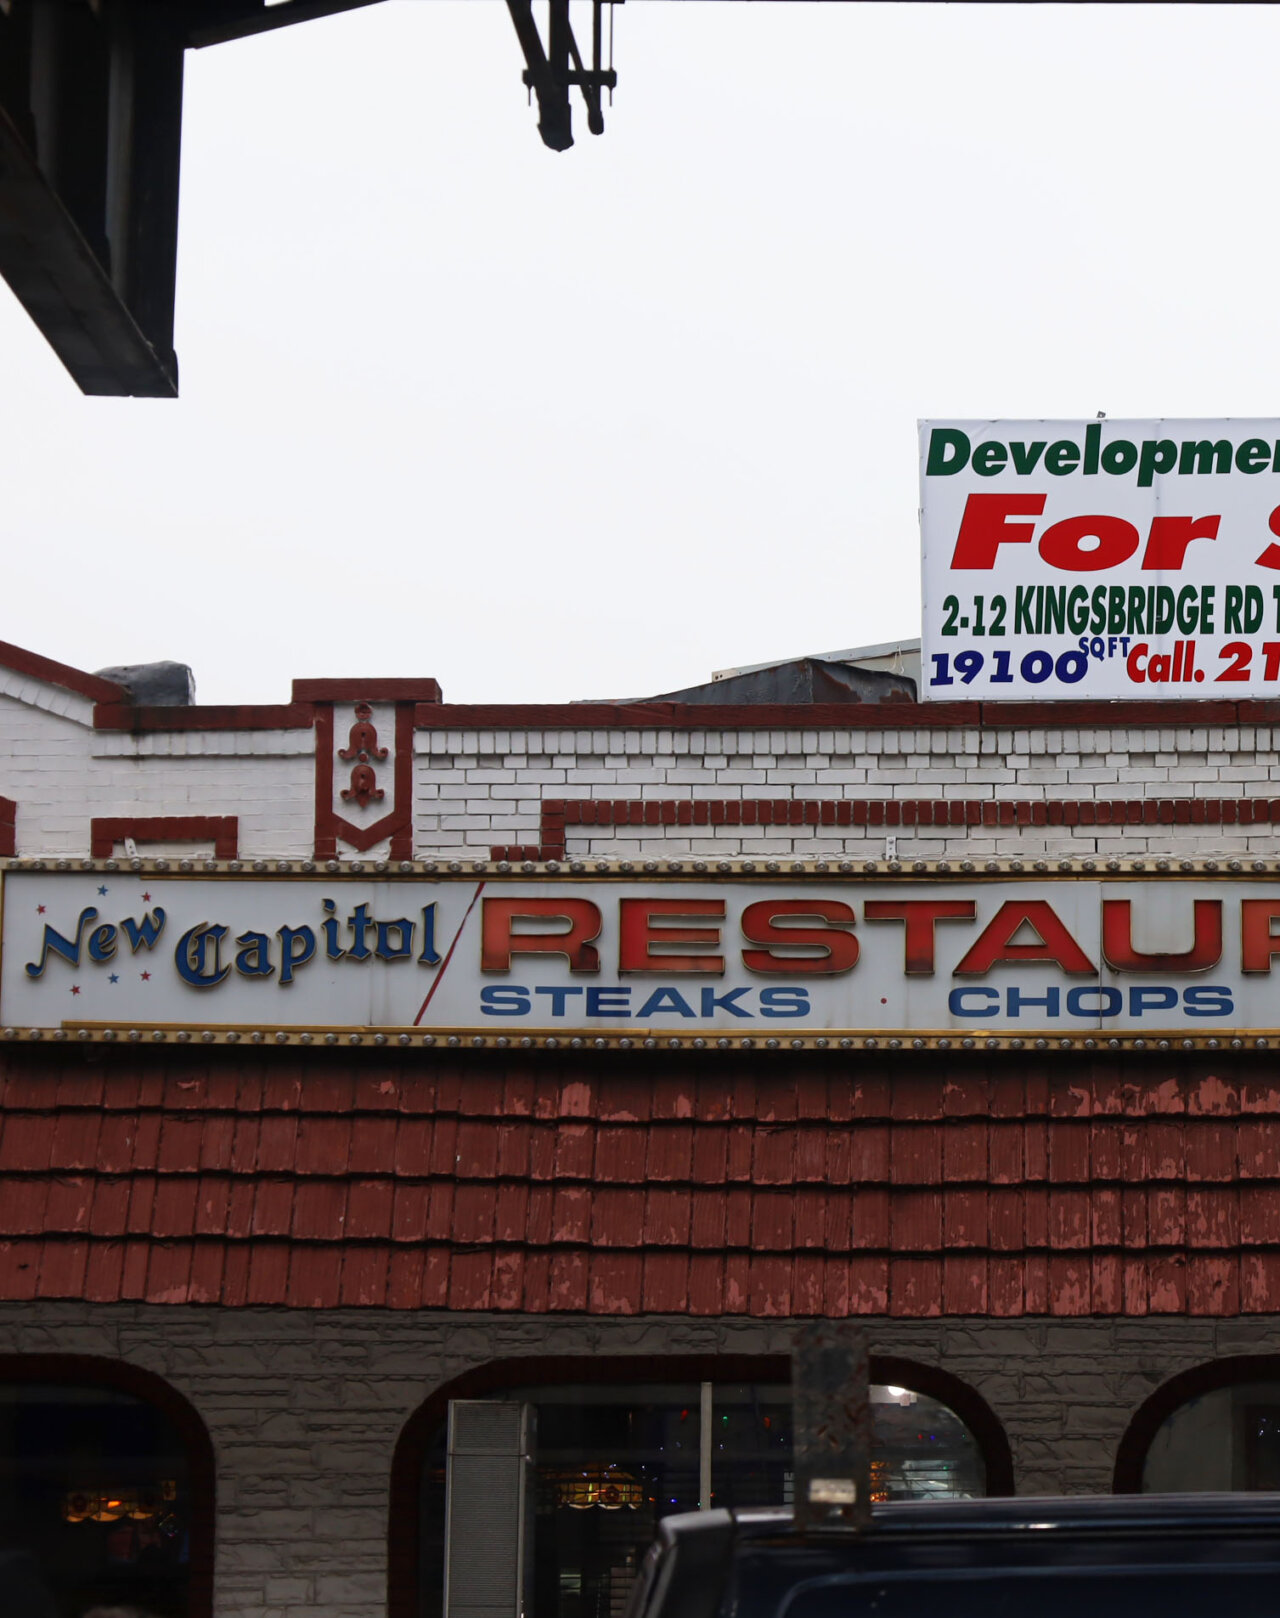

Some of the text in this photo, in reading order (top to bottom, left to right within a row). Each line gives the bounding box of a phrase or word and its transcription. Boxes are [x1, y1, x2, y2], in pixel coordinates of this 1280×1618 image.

[951, 494, 1221, 571] For
[942, 595, 1006, 636] 2-12
[1015, 585, 1215, 635] KINGSBRIDGE
[1225, 585, 1263, 634] RD
[930, 650, 1088, 686] 19100
[1128, 640, 1205, 683] Call.
[25, 898, 441, 987] New Capitol
[480, 986, 811, 1017] STEAKS
[948, 987, 1234, 1017] CHOPS
